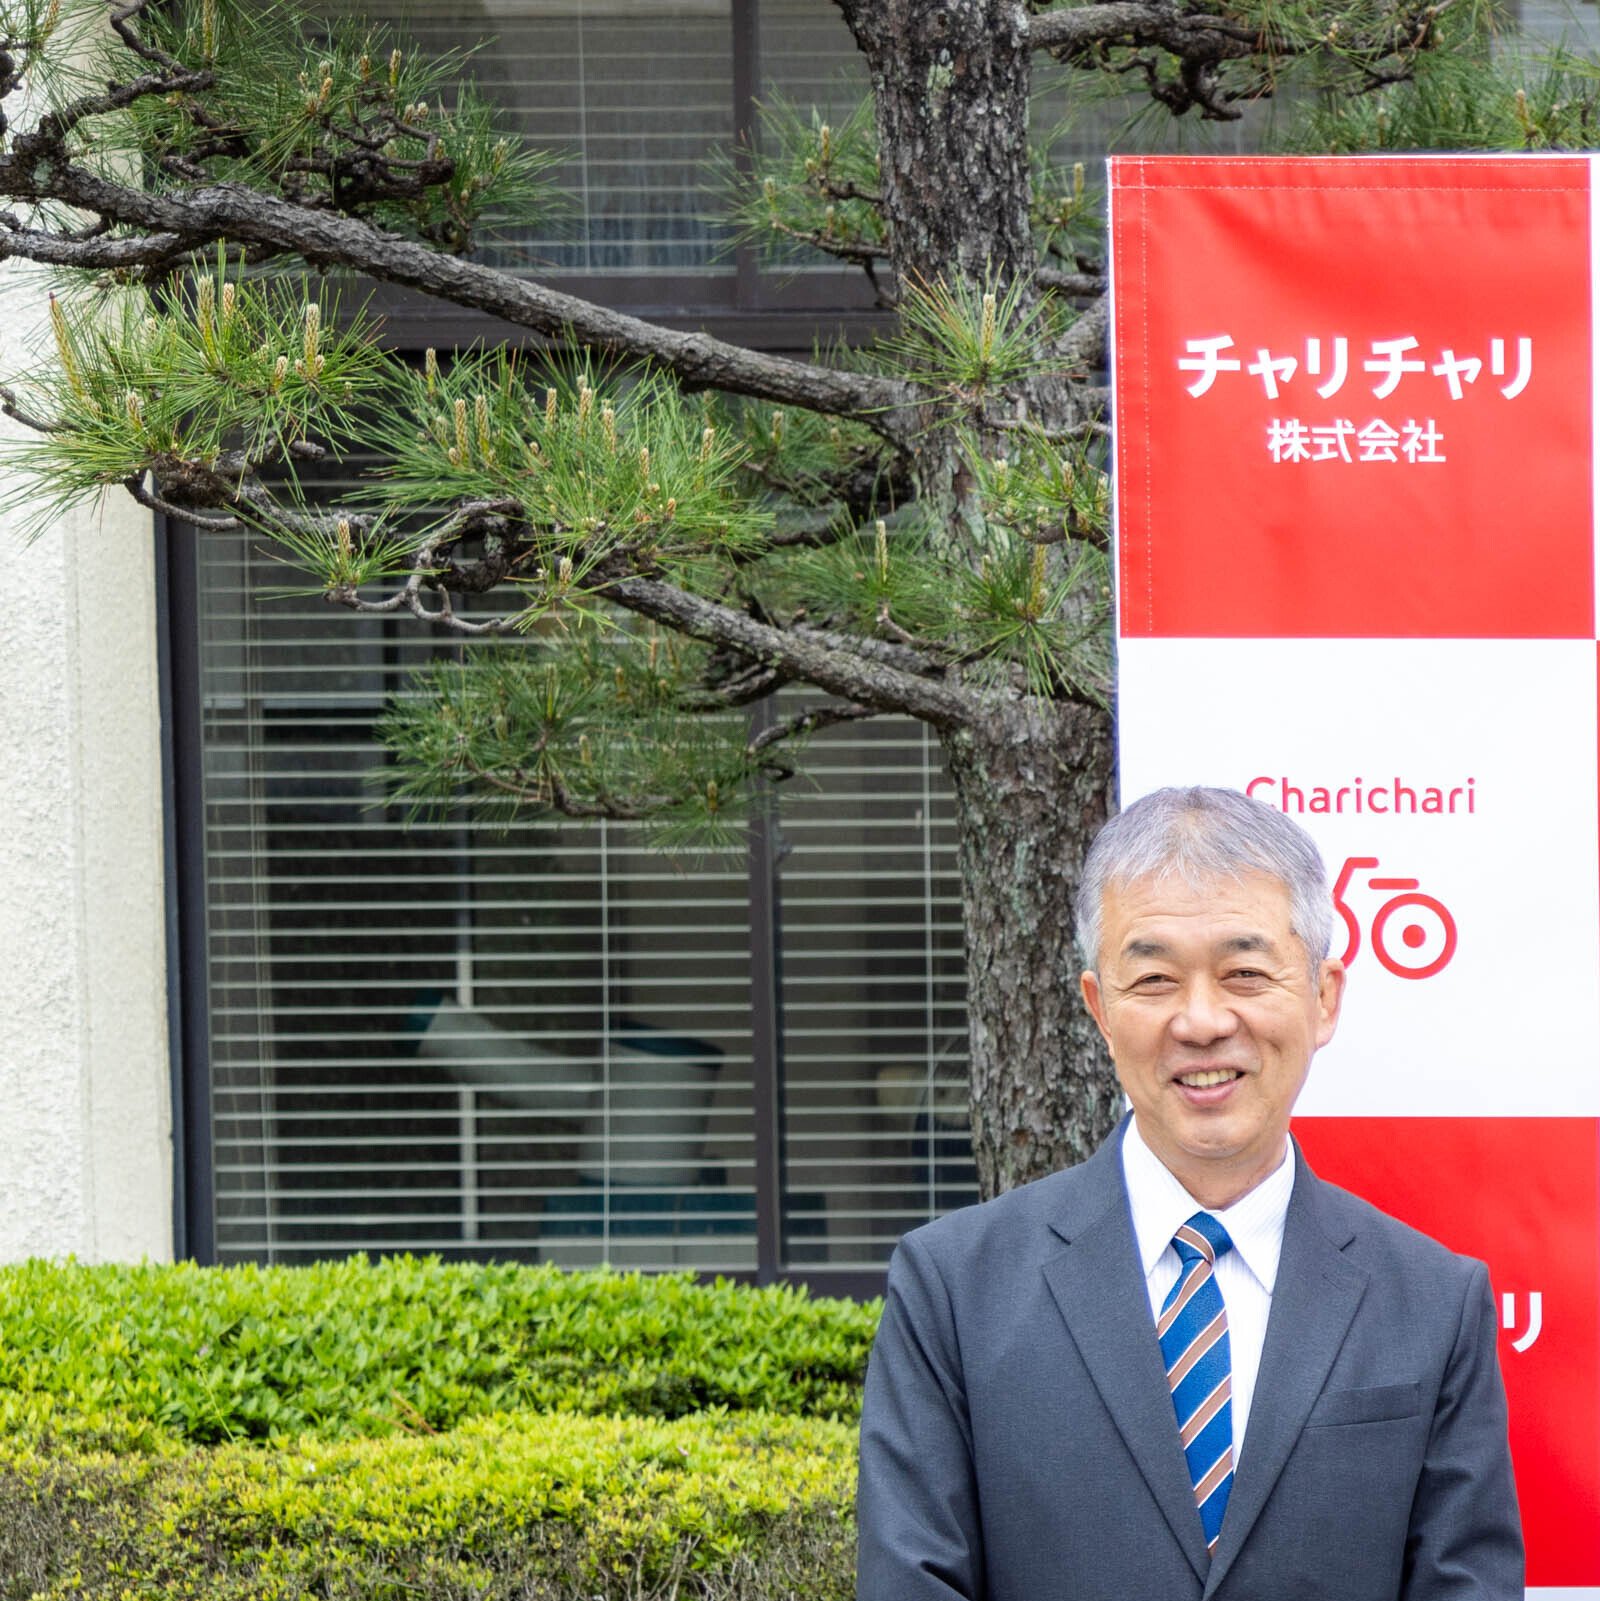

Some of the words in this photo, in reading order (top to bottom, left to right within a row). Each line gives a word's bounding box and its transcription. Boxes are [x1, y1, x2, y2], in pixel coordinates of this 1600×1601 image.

[1177, 334, 1533, 400] チャリチャリ
[1266, 418, 1447, 464] 株式会社
